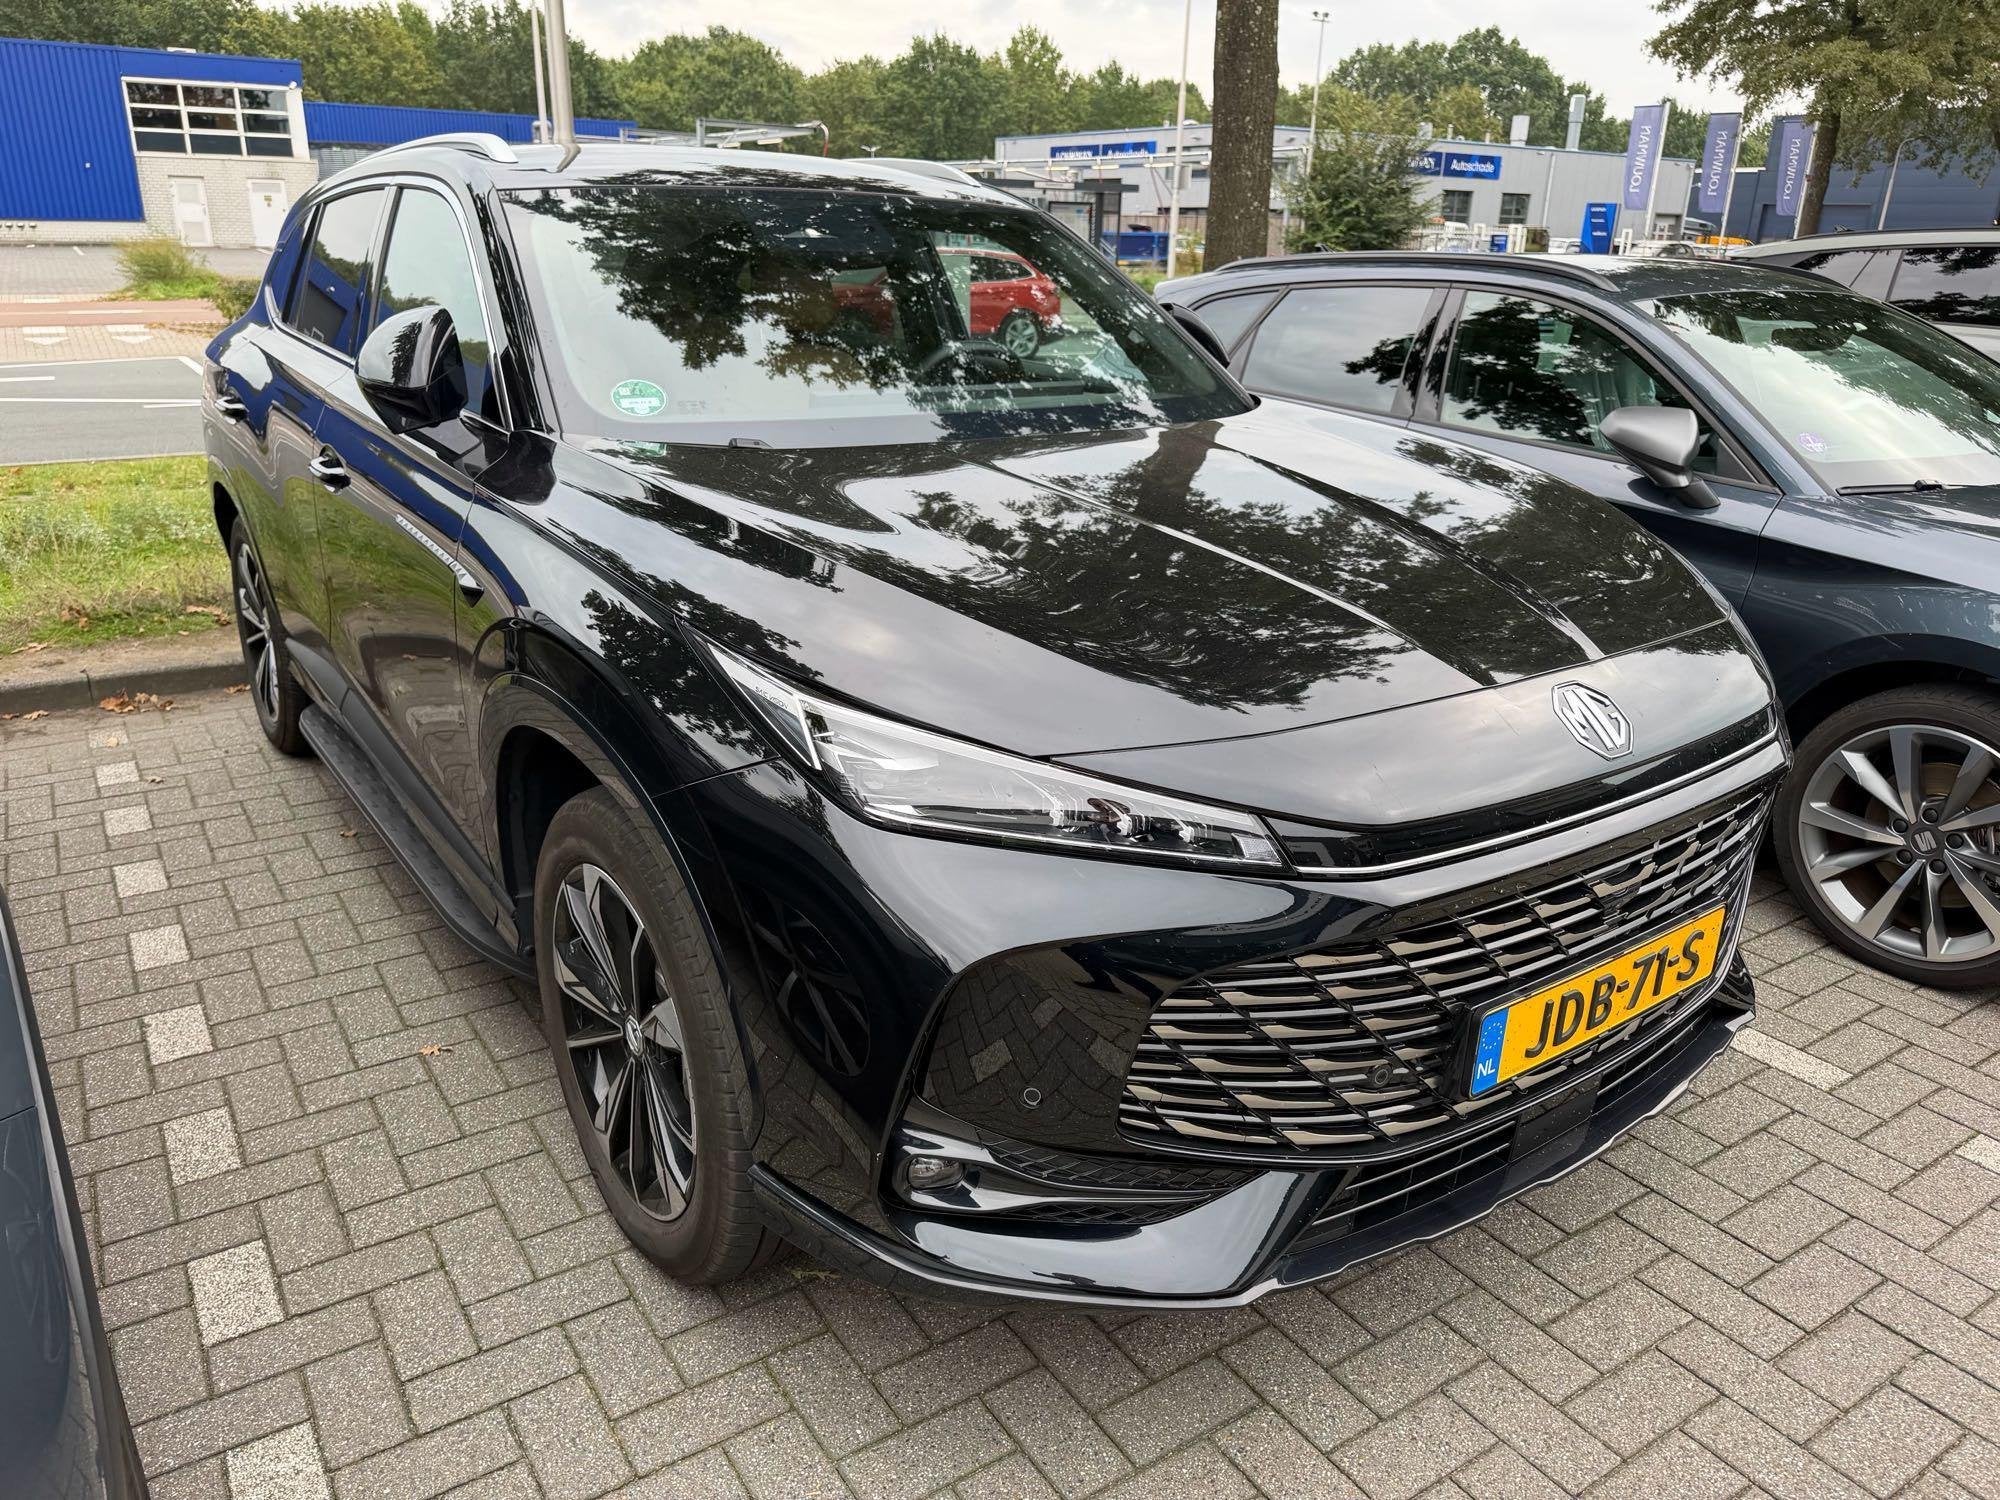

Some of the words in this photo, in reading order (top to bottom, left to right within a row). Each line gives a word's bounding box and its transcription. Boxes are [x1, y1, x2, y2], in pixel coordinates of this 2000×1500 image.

[1451, 159, 1495, 173] Autoschade
[1556, 685, 1628, 752] MG
[1524, 929, 1705, 1058] JDB-71-S
[1476, 1058, 1496, 1080] NL
